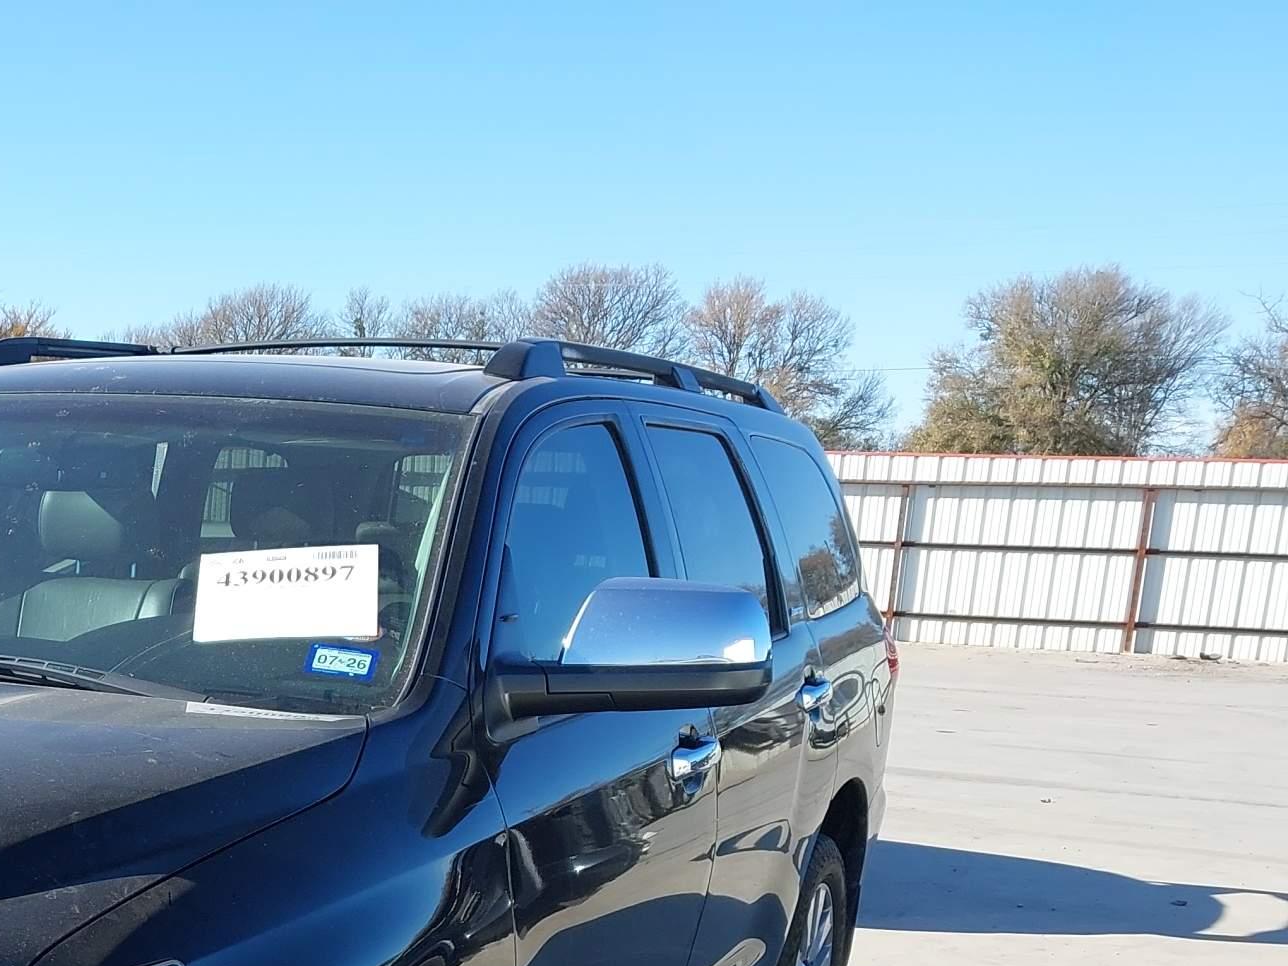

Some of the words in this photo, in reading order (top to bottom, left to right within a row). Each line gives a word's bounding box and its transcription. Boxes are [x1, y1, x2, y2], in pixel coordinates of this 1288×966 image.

[216, 565, 355, 587] 43900897
[317, 654, 339, 665] 07
[346, 657, 368, 670] 26
